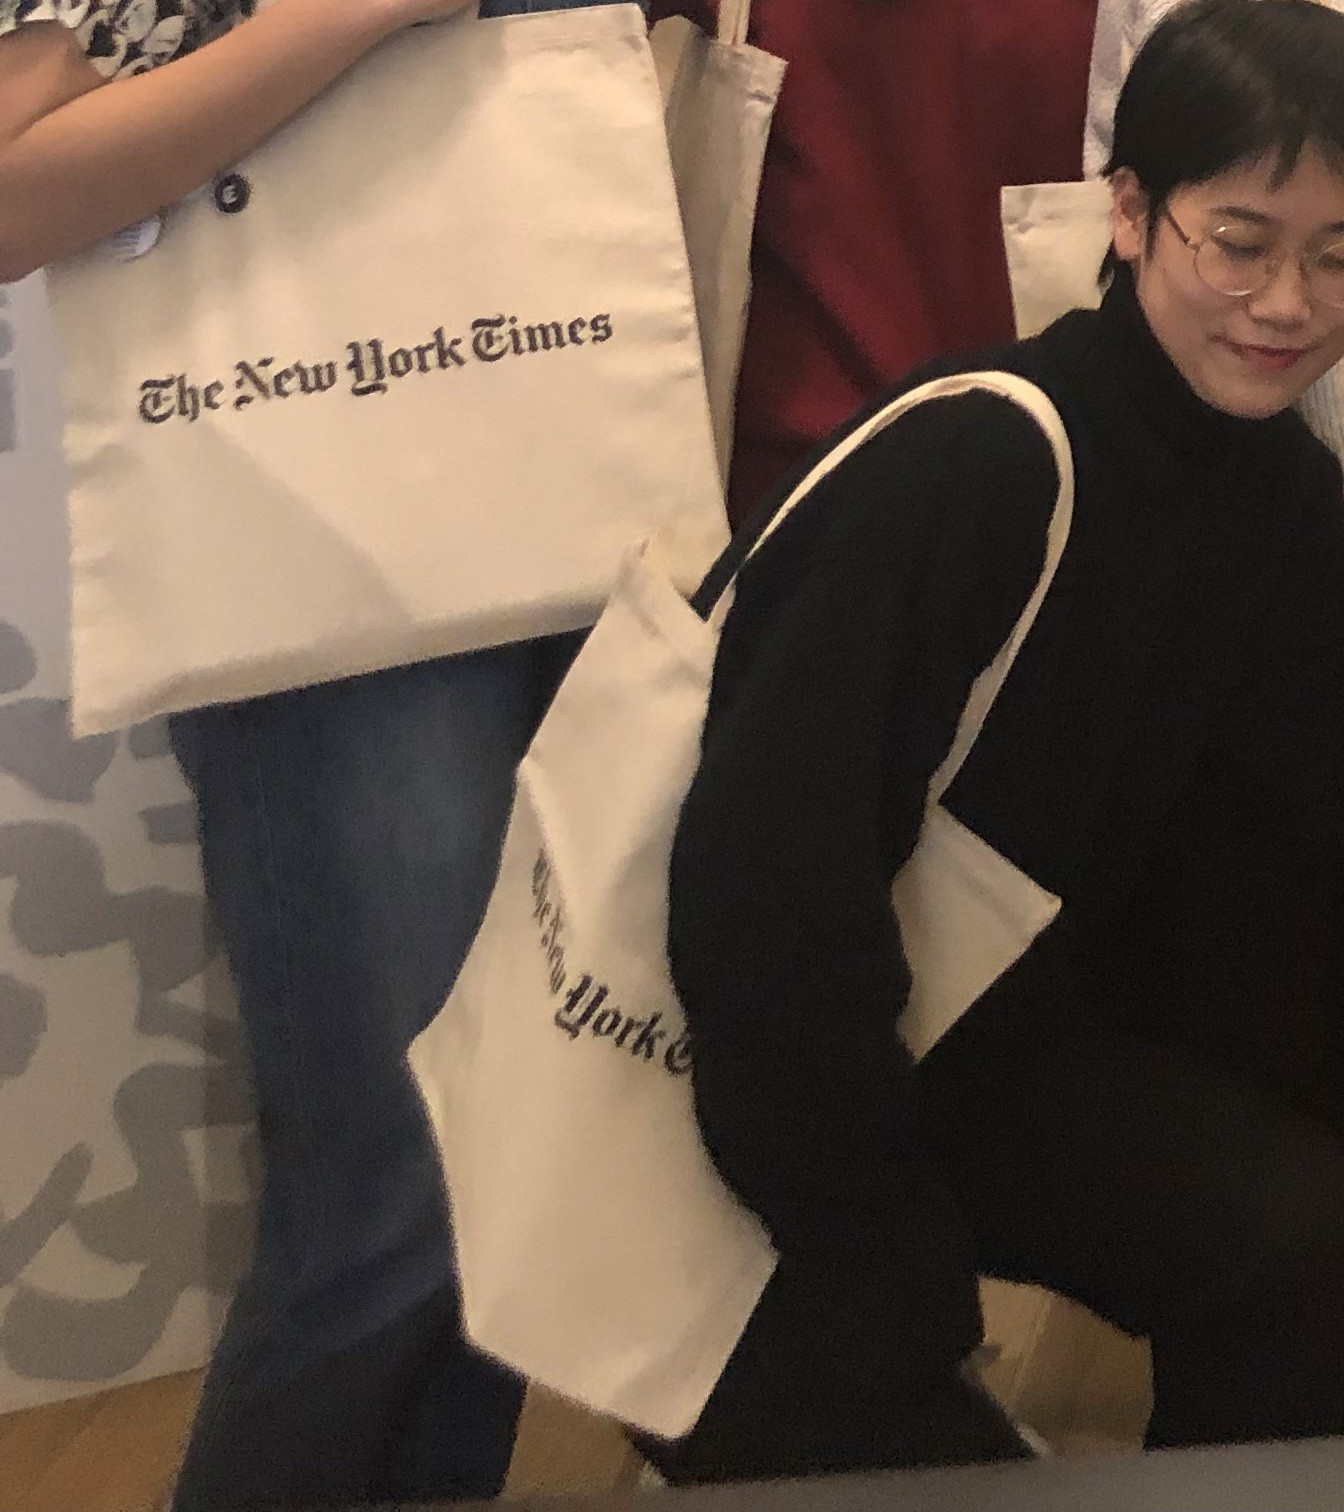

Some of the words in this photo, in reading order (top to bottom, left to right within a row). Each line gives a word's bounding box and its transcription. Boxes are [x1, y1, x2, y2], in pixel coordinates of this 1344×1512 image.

[138, 374, 225, 425] The
[233, 356, 339, 412] New
[346, 325, 467, 397] York
[471, 310, 615, 363] Times
[554, 972, 667, 1063] York
